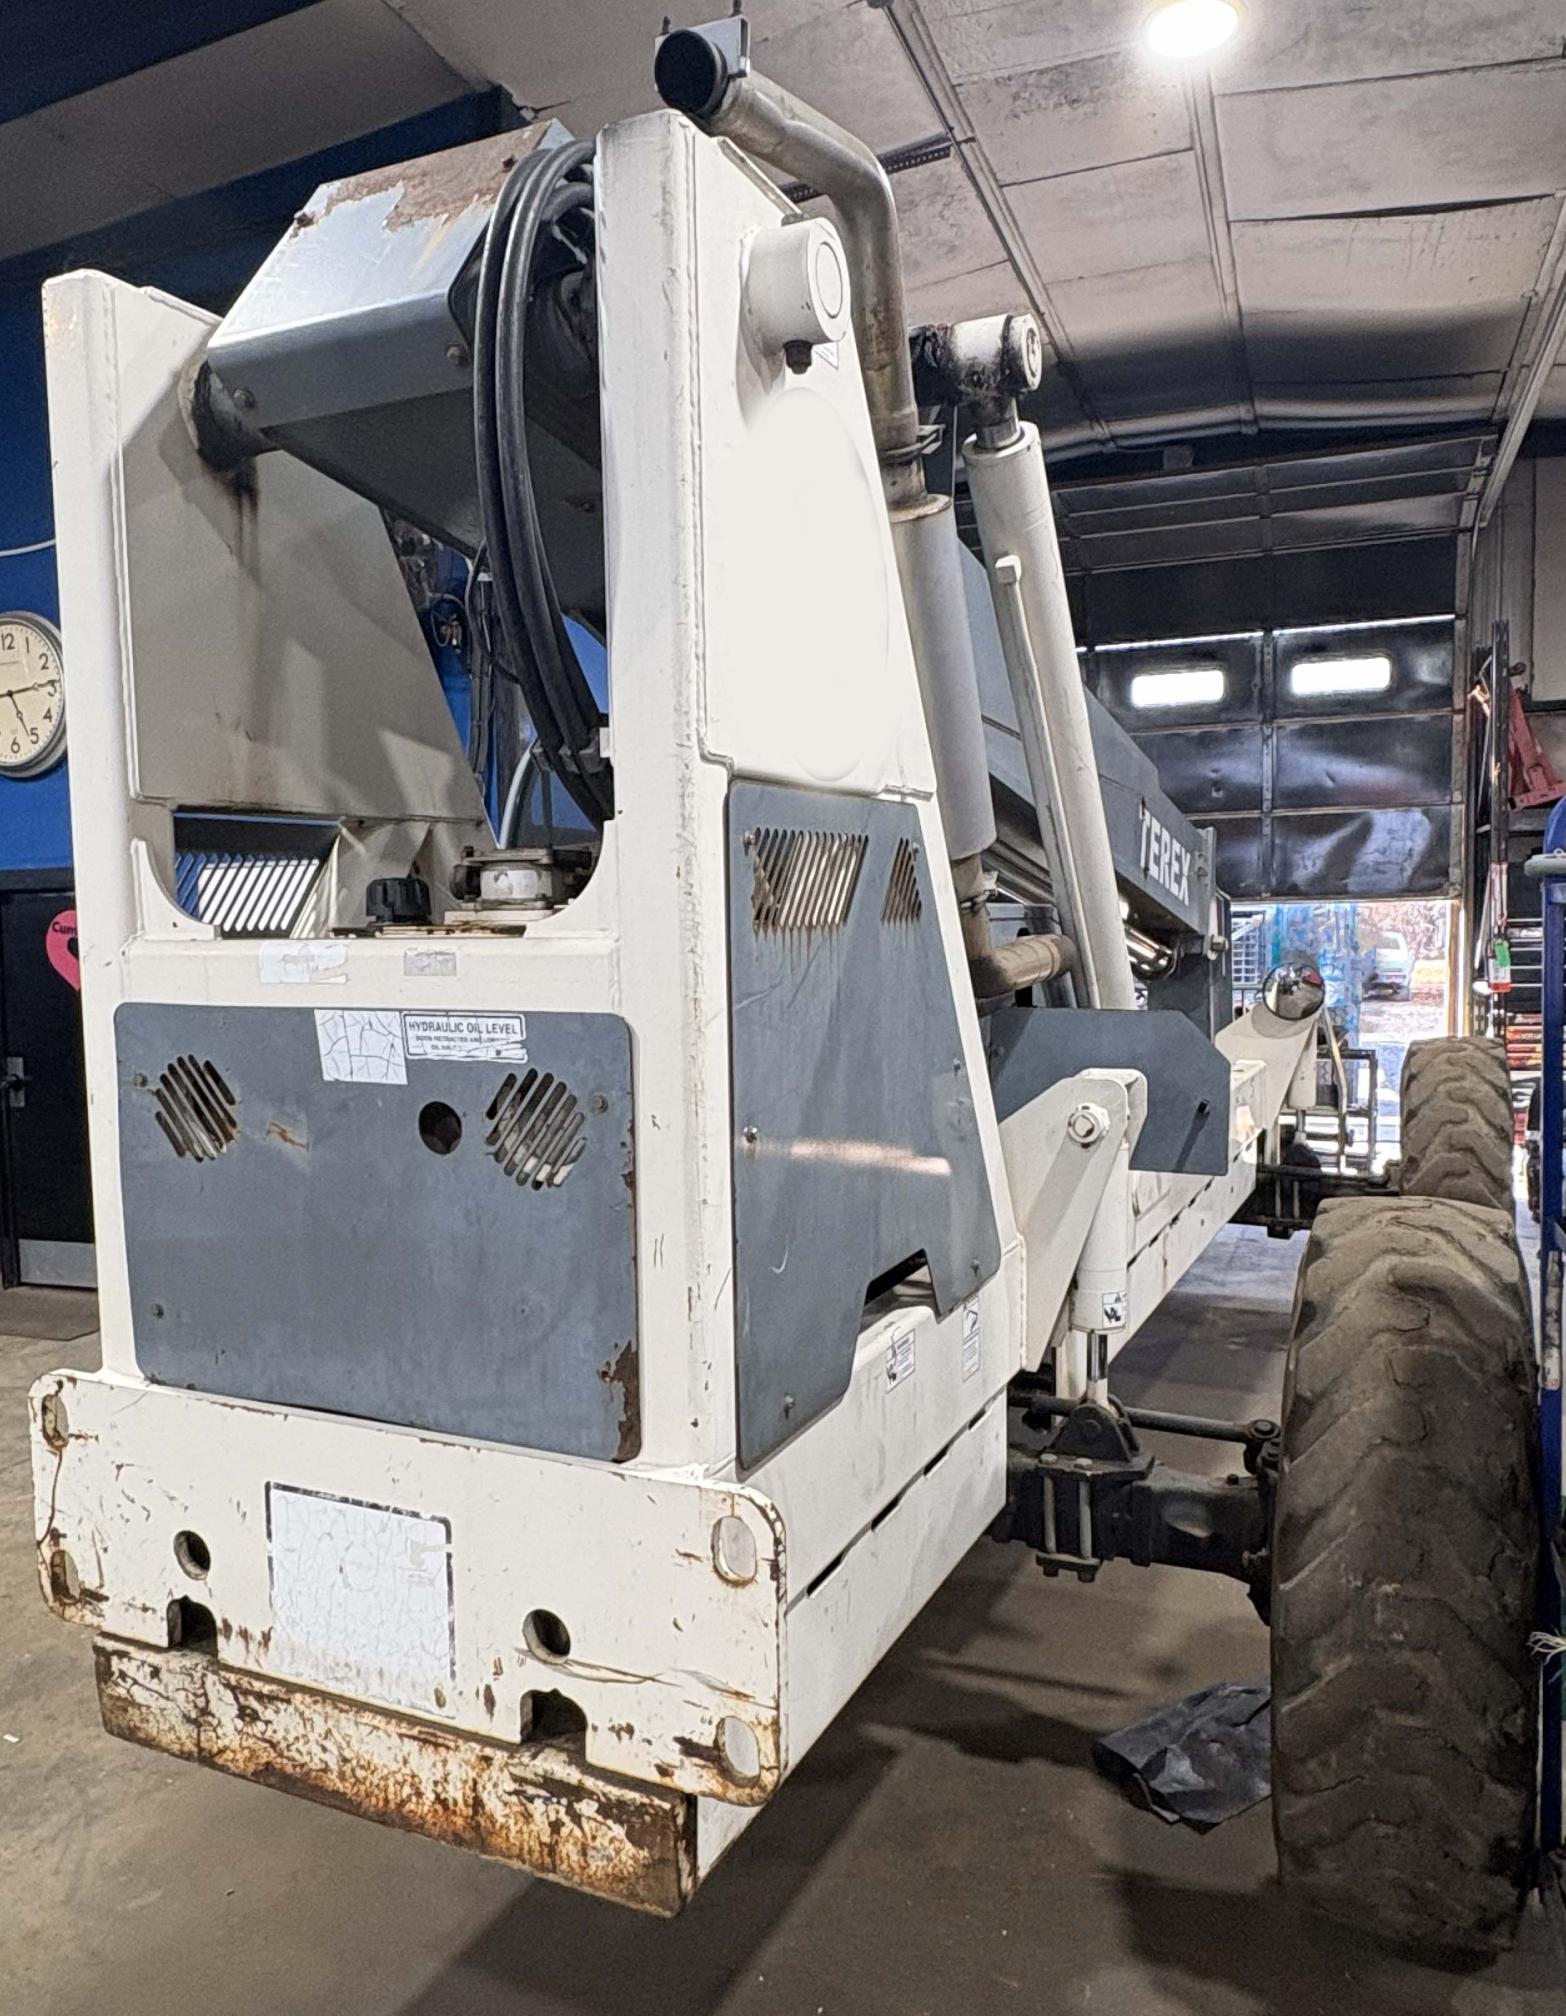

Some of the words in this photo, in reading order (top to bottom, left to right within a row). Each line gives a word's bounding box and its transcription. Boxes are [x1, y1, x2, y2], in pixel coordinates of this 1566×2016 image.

[1, 633, 15, 651] 12
[39, 653, 49, 670] 2
[43, 707, 52, 722] 4
[10, 736, 21, 754] 6
[30, 728, 39, 745] 5
[1139, 803, 1190, 906] TEREX
[409, 1021, 464, 1033] HYDRAULIC
[466, 1022, 483, 1034] OIL
[486, 1023, 518, 1035] LEVEL
